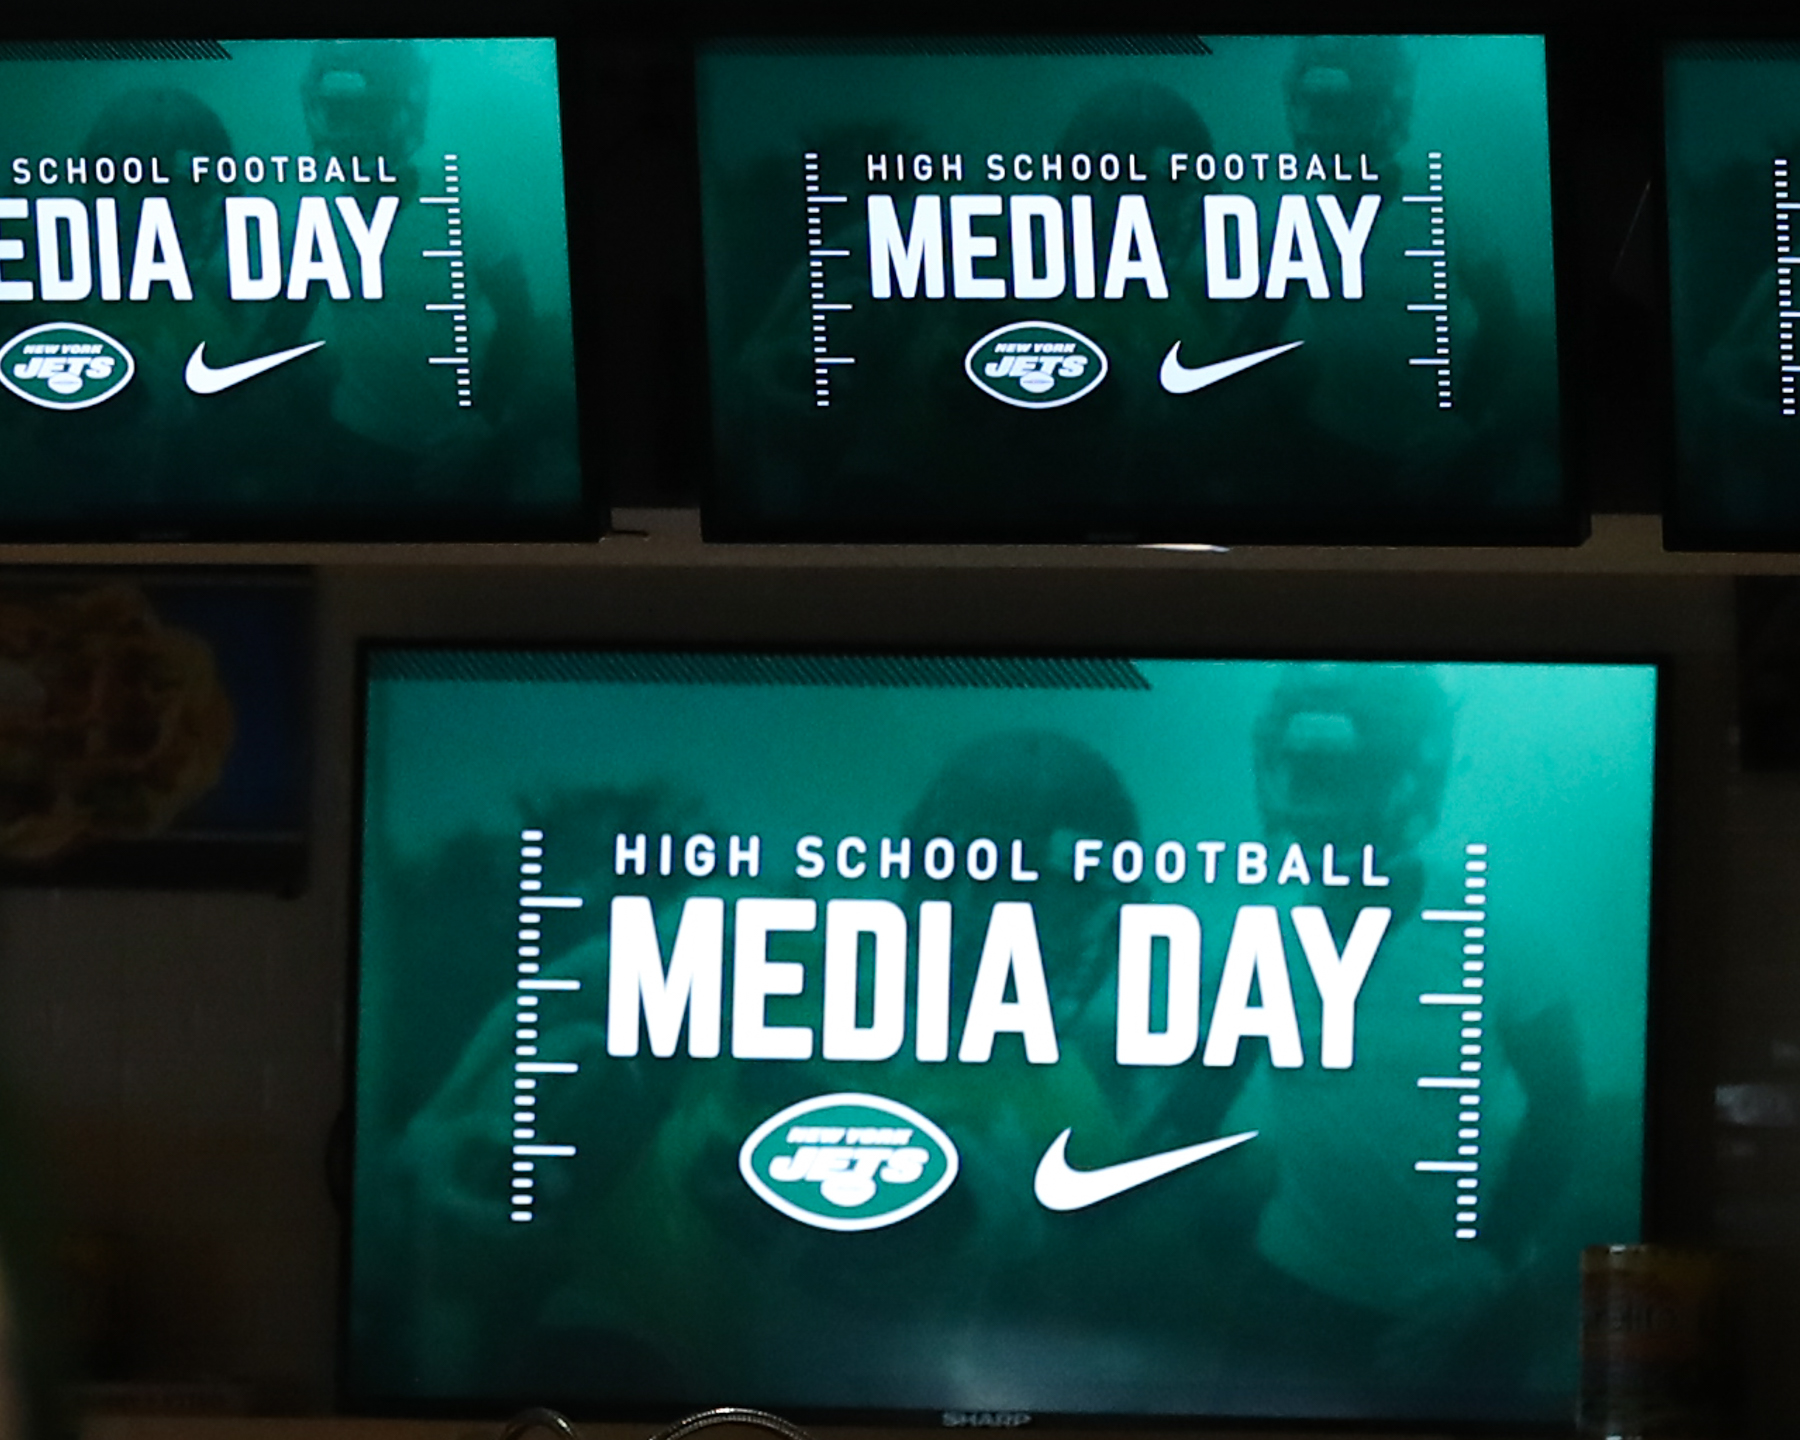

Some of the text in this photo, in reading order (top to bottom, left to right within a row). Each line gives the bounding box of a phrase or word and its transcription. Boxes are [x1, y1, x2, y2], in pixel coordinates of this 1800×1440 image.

[11, 156, 170, 185] SCHOOL
[191, 155, 398, 184] FOOTBALL
[866, 152, 1380, 182] HIGH SCHOOL FOOTBALL
[224, 195, 401, 301] DAY
[866, 193, 1382, 300] MEDIA DAY
[23, 344, 104, 355] NEW YORK
[994, 342, 1077, 353] NEW YORK
[12, 355, 116, 380] JETS
[984, 354, 1089, 379] JETS
[614, 832, 1390, 888] HIGH SCHOOL FOOTBALL
[606, 895, 1393, 1070] MEDIA DAY
[768, 1146, 930, 1184] JETS
